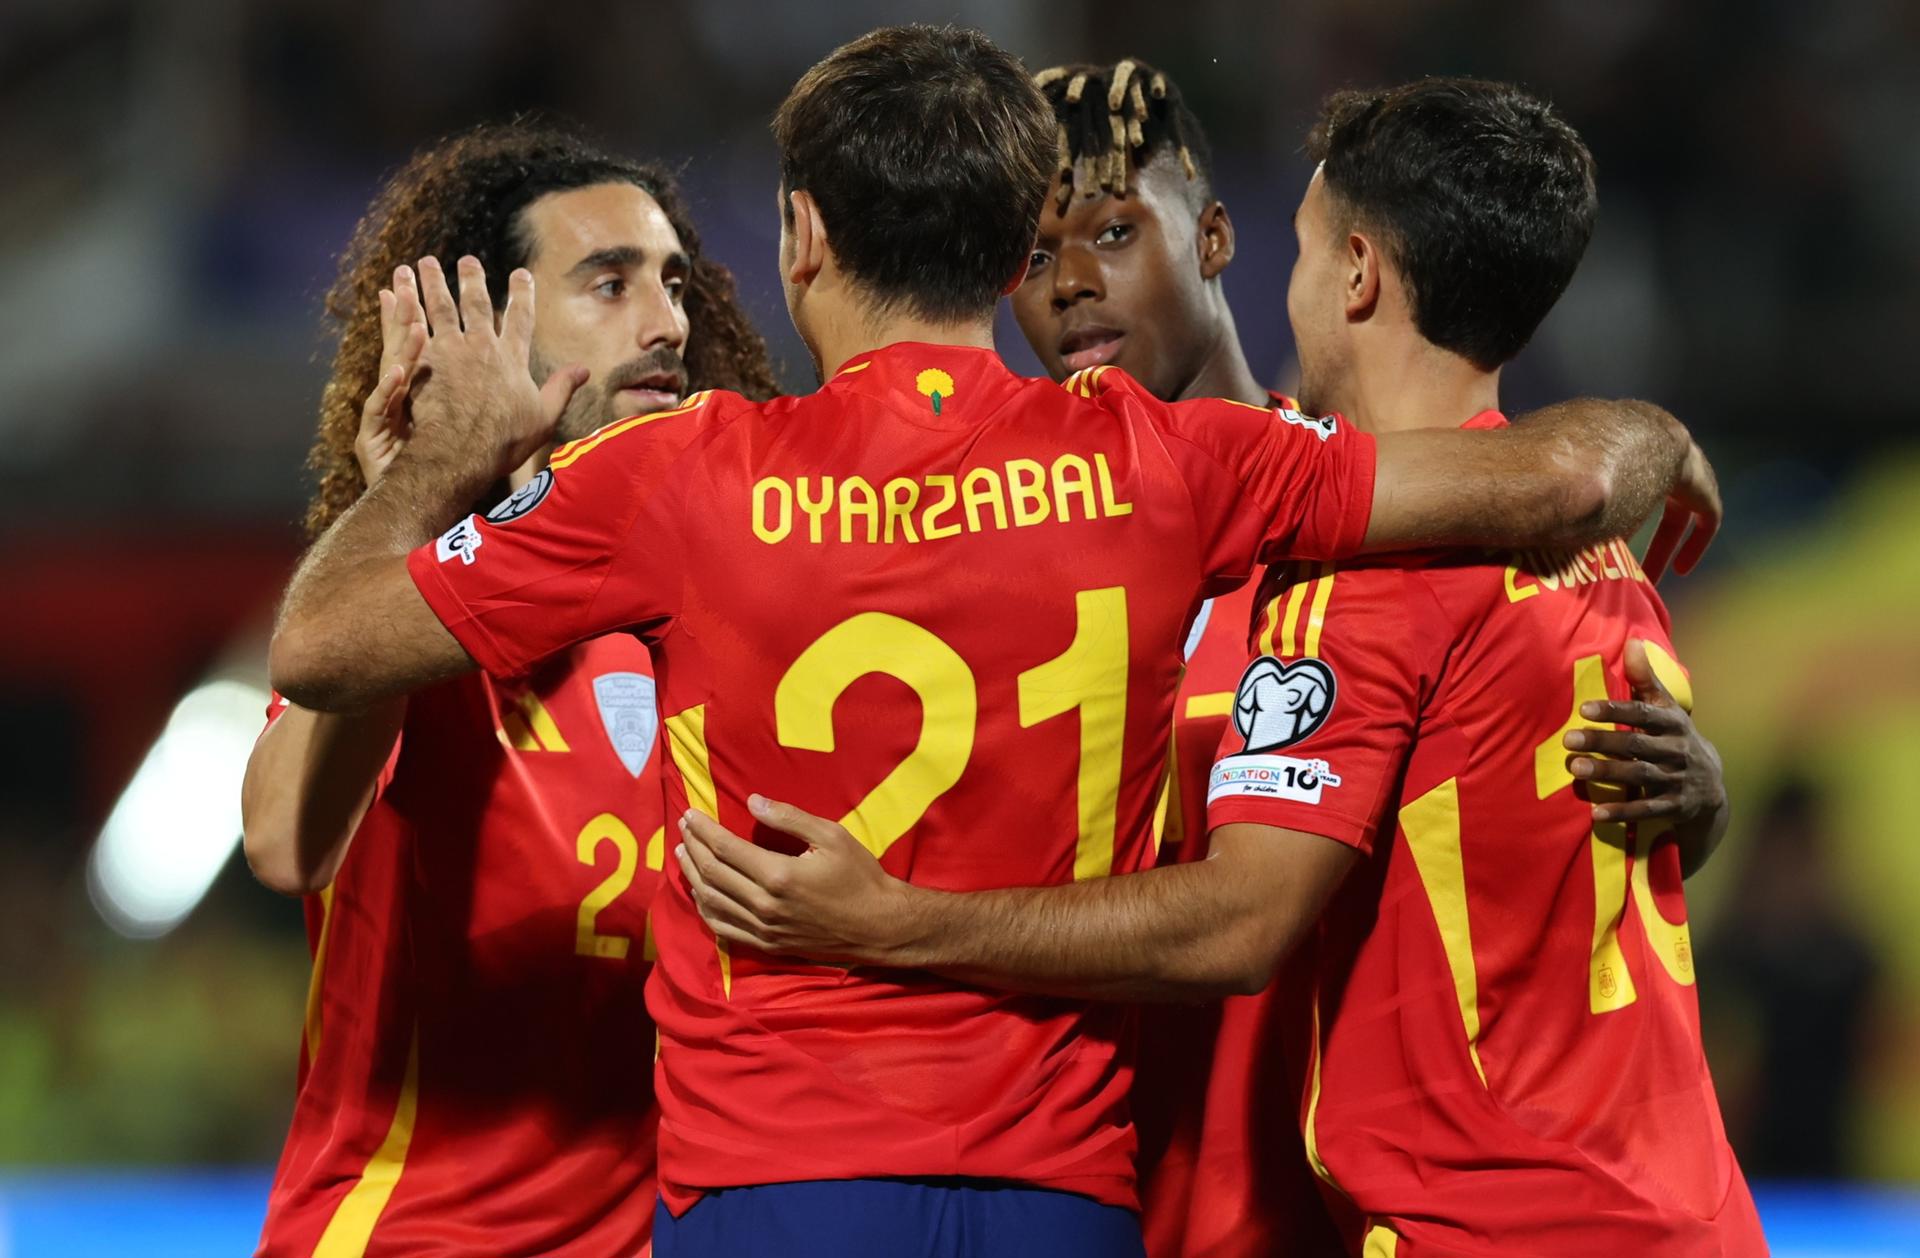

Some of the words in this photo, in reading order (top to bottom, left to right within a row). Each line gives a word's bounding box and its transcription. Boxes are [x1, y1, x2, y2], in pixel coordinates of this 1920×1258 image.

[751, 453, 1133, 544] OYARZABAL
[775, 586, 1129, 882] 21
[1284, 766, 1319, 790] 10
[576, 813, 664, 959] 2
